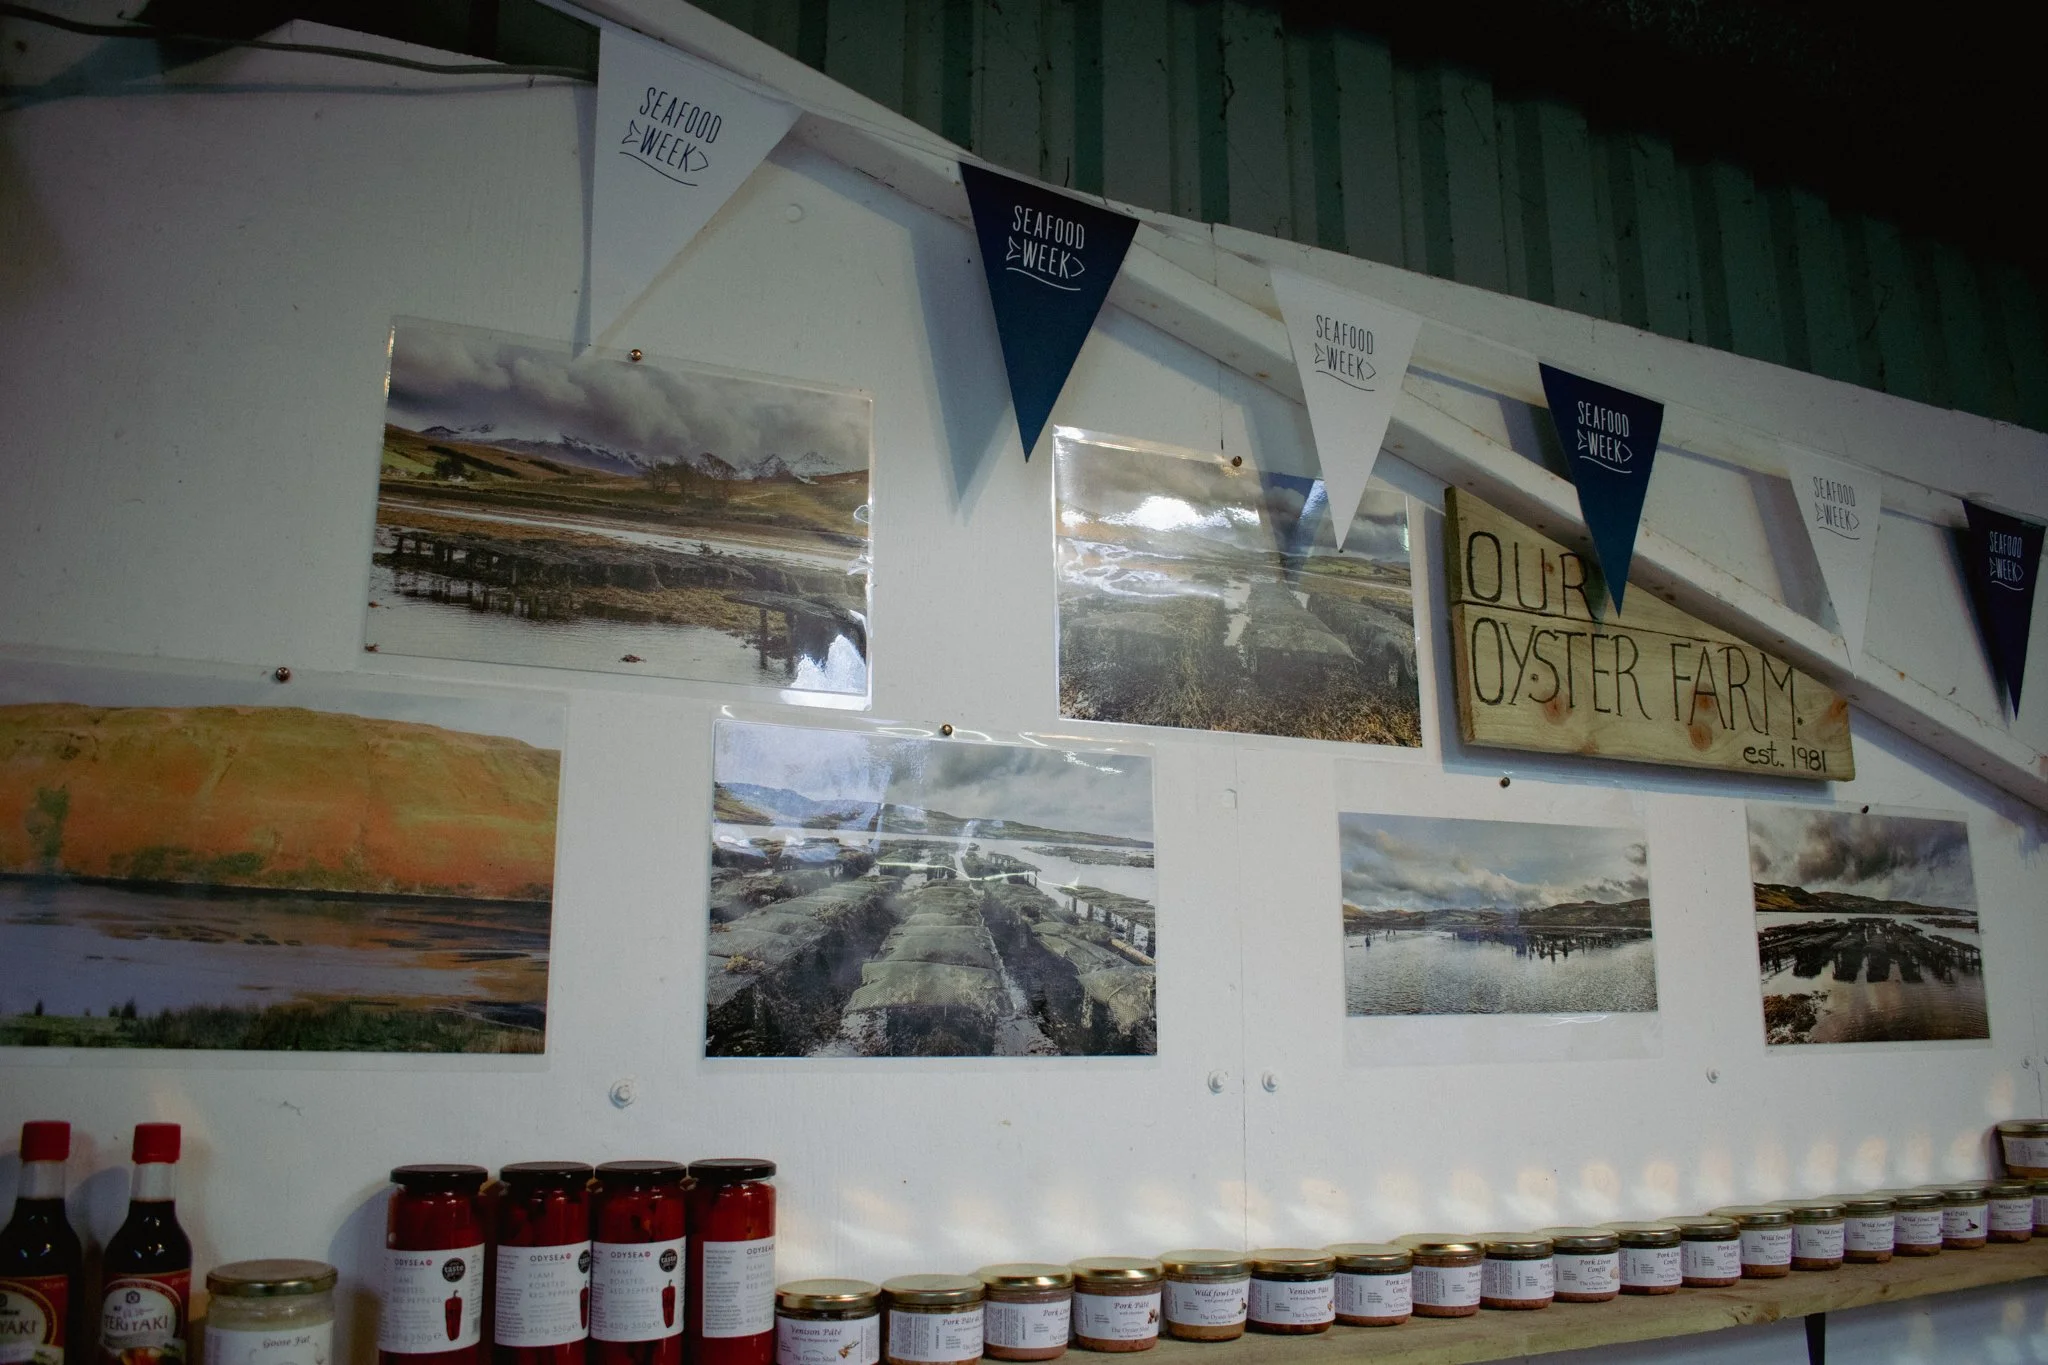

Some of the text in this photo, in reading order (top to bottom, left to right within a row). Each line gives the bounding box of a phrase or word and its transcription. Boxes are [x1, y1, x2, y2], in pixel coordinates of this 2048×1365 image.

[639, 86, 723, 144] SEAFOOD
[639, 124, 697, 173] WEEK
[1012, 204, 1085, 250] SEAFOOD
[1022, 238, 1071, 279] WEEK
[1316, 314, 1374, 355] SEAFOOD
[1326, 344, 1365, 381] WEEK
[1577, 400, 1630, 438] SEAFOOD
[1587, 430, 1623, 464] WEEK
[1812, 476, 1856, 507] SEAFOOD
[1822, 503, 1853, 531] WEEK
[1989, 530, 2023, 558] SEAFOOD
[1466, 531, 1602, 621] OUR
[1995, 557, 2019, 582] WEEK
[1471, 617, 1652, 721] OYSTER
[1743, 743, 1828, 773] est. 1981
[394, 1258, 425, 1267] ODYSEA
[529, 1254, 566, 1263] ODYSEA
[610, 1251, 645, 1259] ODYSEA
[746, 1245, 772, 1255] ODYSEA
[444, 1265, 464, 1273] taste
[1587, 1266, 1606, 1274] Confit
[1193, 1288, 1212, 1297] Wild
[1213, 1287, 1229, 1298] fowl
[1288, 1287, 1316, 1295] Venison
[1042, 1308, 1059, 1317] Pork
[1113, 1302, 1133, 1310] Pork
[103, 1314, 169, 1332] TERIYAKI
[790, 1324, 842, 1336] Venison Pâté
[942, 1318, 960, 1326] Pork
[262, 1338, 292, 1349] Goose
